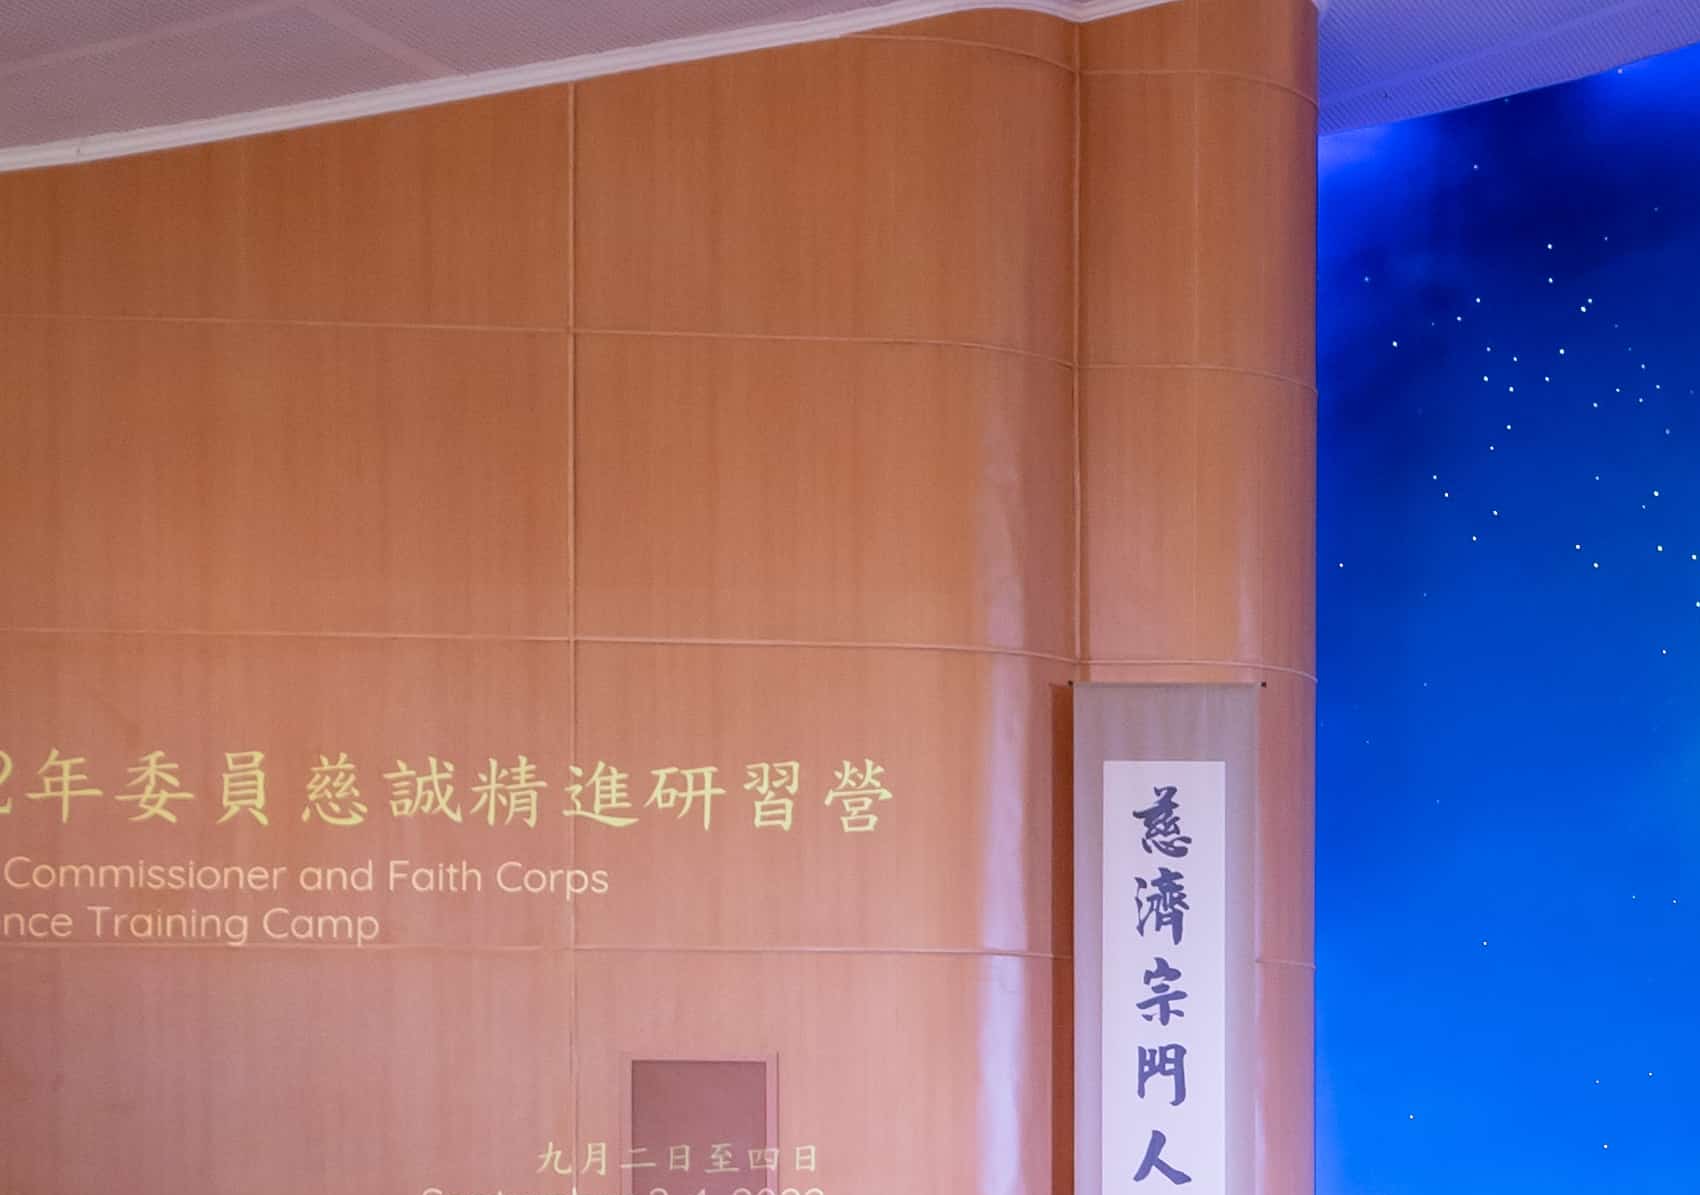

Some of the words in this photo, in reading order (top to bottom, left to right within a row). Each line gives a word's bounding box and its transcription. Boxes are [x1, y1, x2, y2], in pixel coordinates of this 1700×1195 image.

[3, 855, 287, 890] Commissioner
[299, 860, 374, 892] and
[388, 859, 482, 894] Faith
[496, 860, 609, 901] Corps
[87, 905, 250, 947] Training
[262, 907, 381, 948] Camp
[535, 1141, 818, 1176] 九月二日至四日
